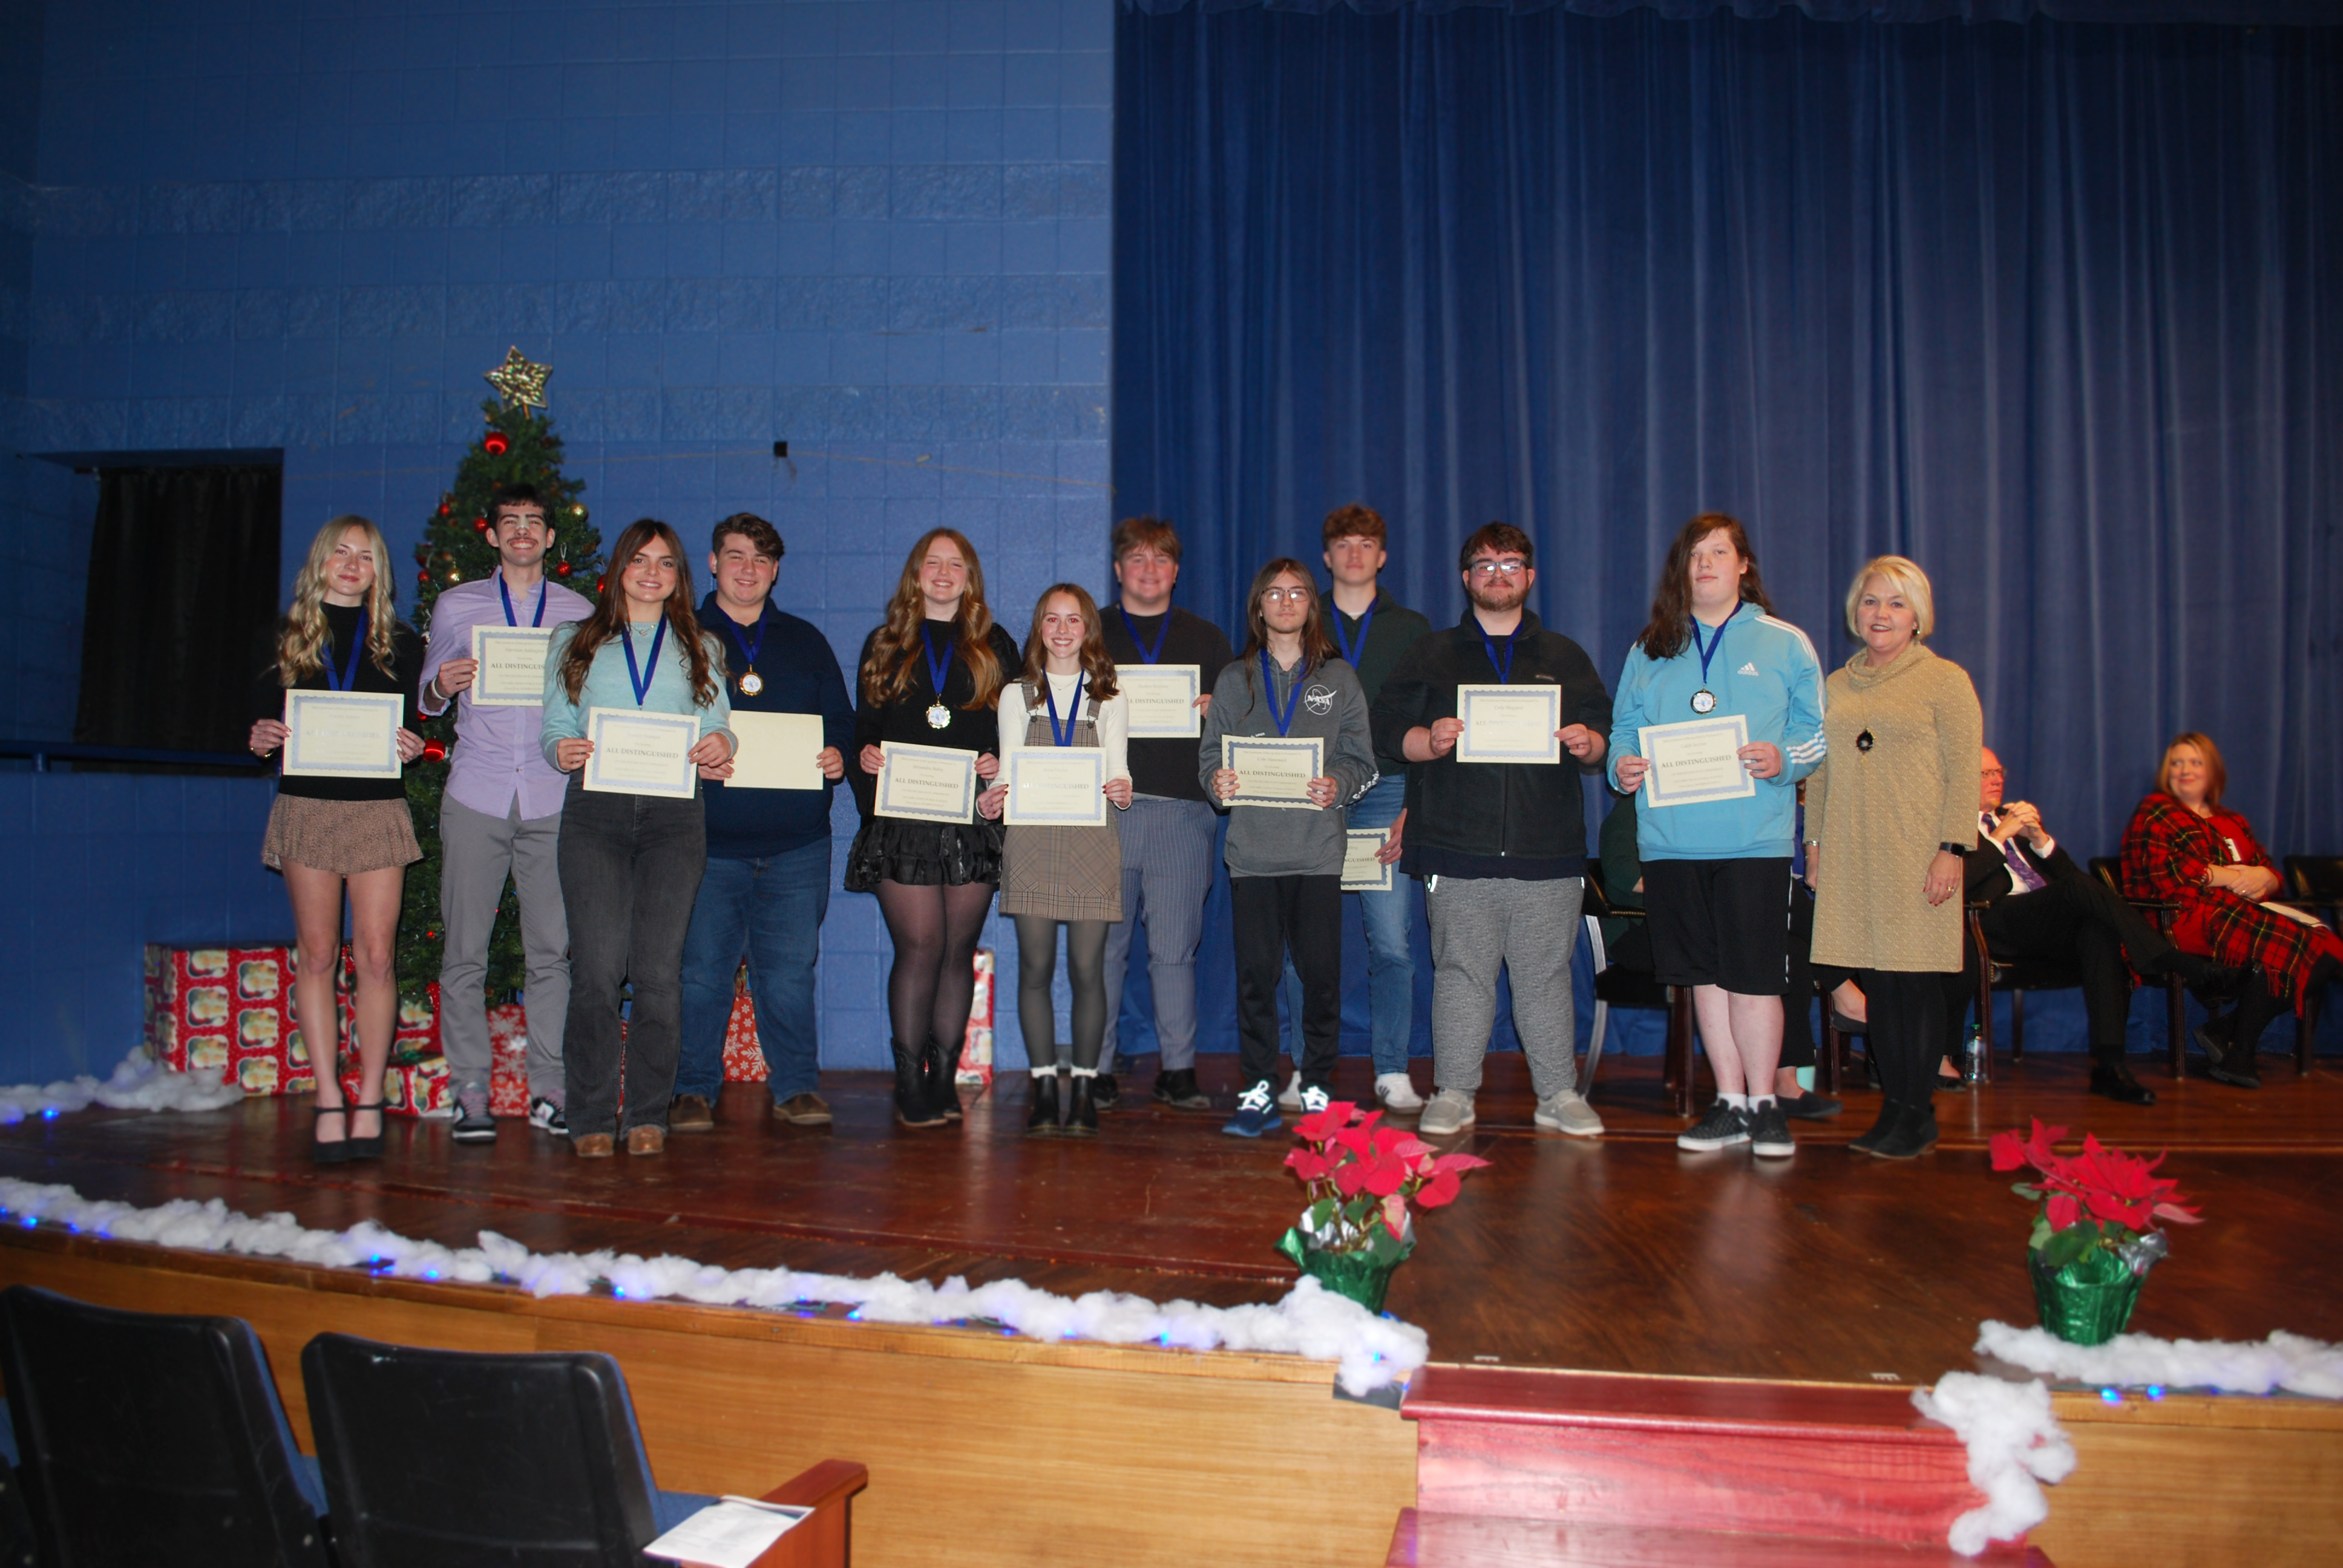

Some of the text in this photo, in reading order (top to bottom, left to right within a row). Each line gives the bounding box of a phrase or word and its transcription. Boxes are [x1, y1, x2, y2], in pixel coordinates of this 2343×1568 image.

[621, 748, 678, 759] DISTINGUISHED
[1676, 755, 1731, 766] DISTINGUISHED
[908, 779, 958, 789] DISTINGUISHED
